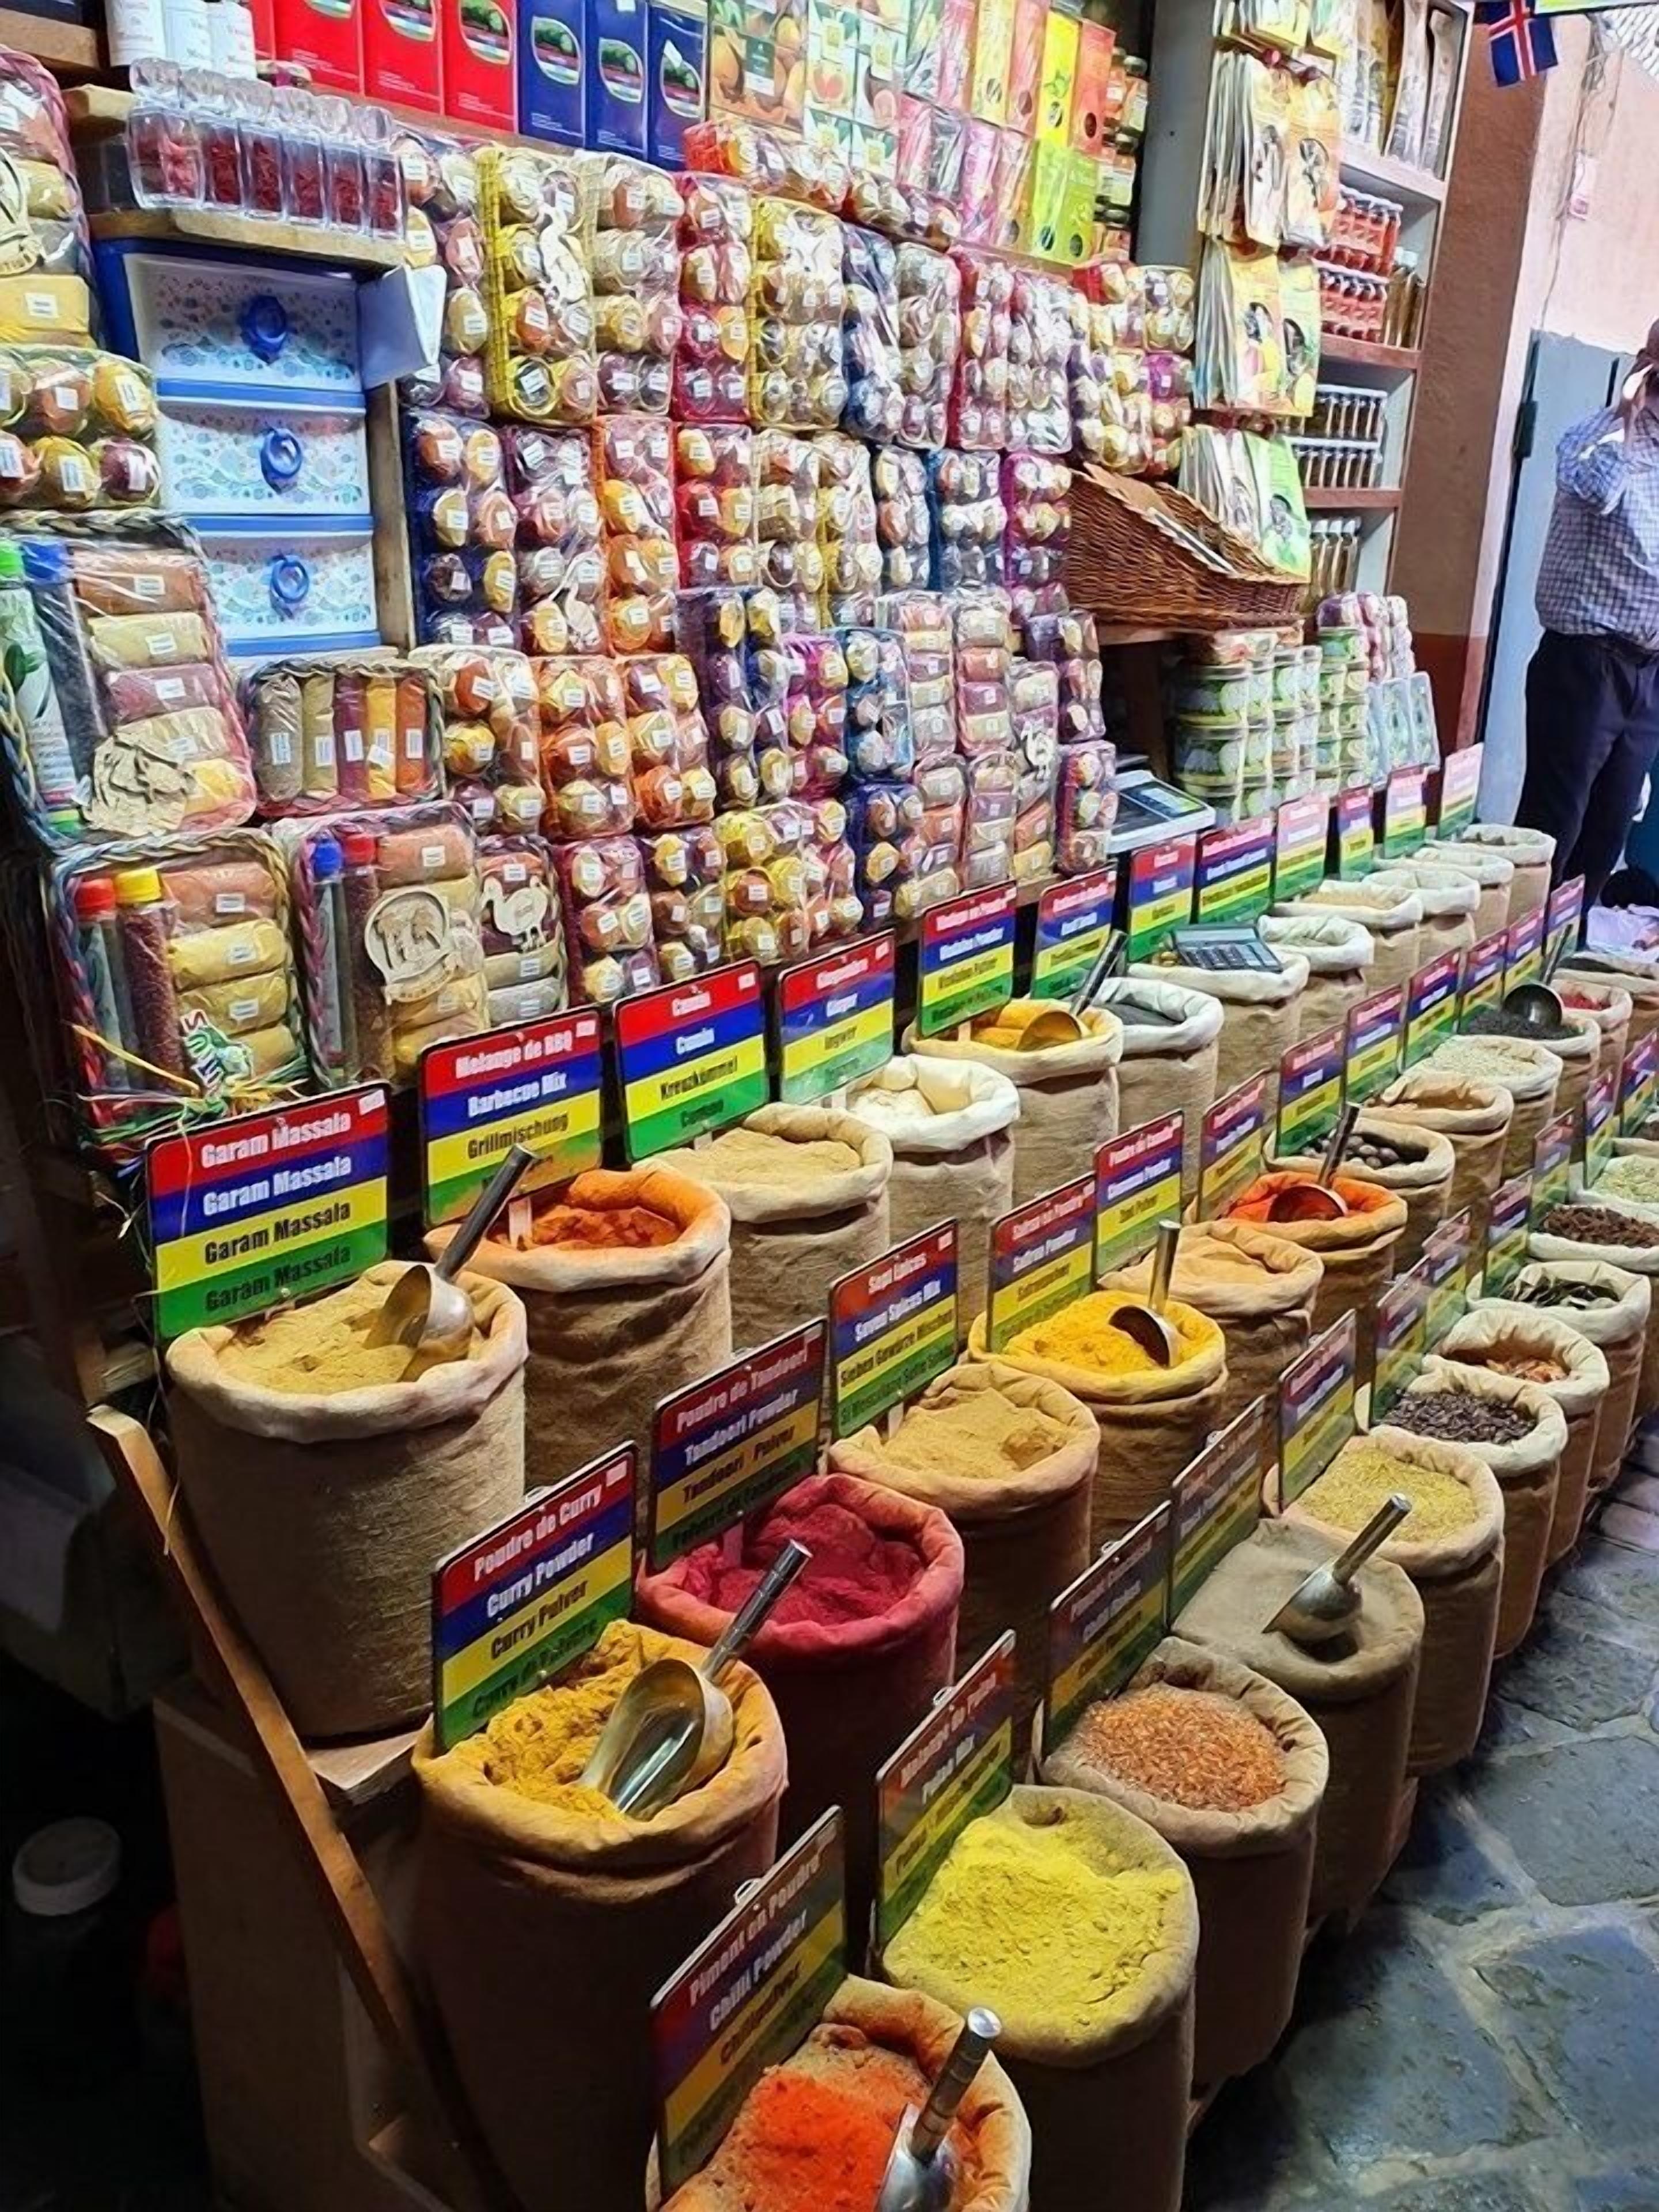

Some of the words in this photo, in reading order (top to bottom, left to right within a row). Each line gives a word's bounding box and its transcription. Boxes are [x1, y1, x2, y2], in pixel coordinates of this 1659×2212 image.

[524, 1040, 542, 1060] de
[544, 1030, 573, 1056] BBQ
[468, 1082, 539, 1118] Barbecue
[542, 1071, 567, 1094] Mix
[202, 1134, 268, 1169] Garam
[271, 1113, 351, 1150] Massala
[468, 1113, 569, 1159] Grillmischung
[203, 1180, 270, 1216] Garam
[273, 1156, 351, 1196] Massala
[205, 1228, 269, 1265] Garam
[274, 1202, 351, 1242] Massala
[206, 1275, 270, 1311] Garam
[274, 1248, 351, 1286] Massala
[677, 1391, 727, 1433] Poudre
[730, 1381, 748, 1403] de
[751, 1346, 807, 1391] Tandoori
[683, 1451, 745, 1502] Tandoori
[753, 1425, 796, 1461] Pulver
[685, 1414, 747, 1466] Tandoori
[749, 1389, 798, 1429] Powder
[474, 1527, 533, 1583] Poudre
[536, 1513, 556, 1541] de
[559, 1484, 602, 1525] Curry
[487, 1572, 533, 1618] Curry
[536, 1532, 594, 1585] Powder
[491, 1612, 536, 1660] Curry
[538, 1580, 588, 1628] Pulver
[690, 1930, 745, 2008] Piment
[748, 1907, 768, 1941] en
[768, 1853, 821, 1919] Poudre
[753, 1908, 807, 1983] Powder
